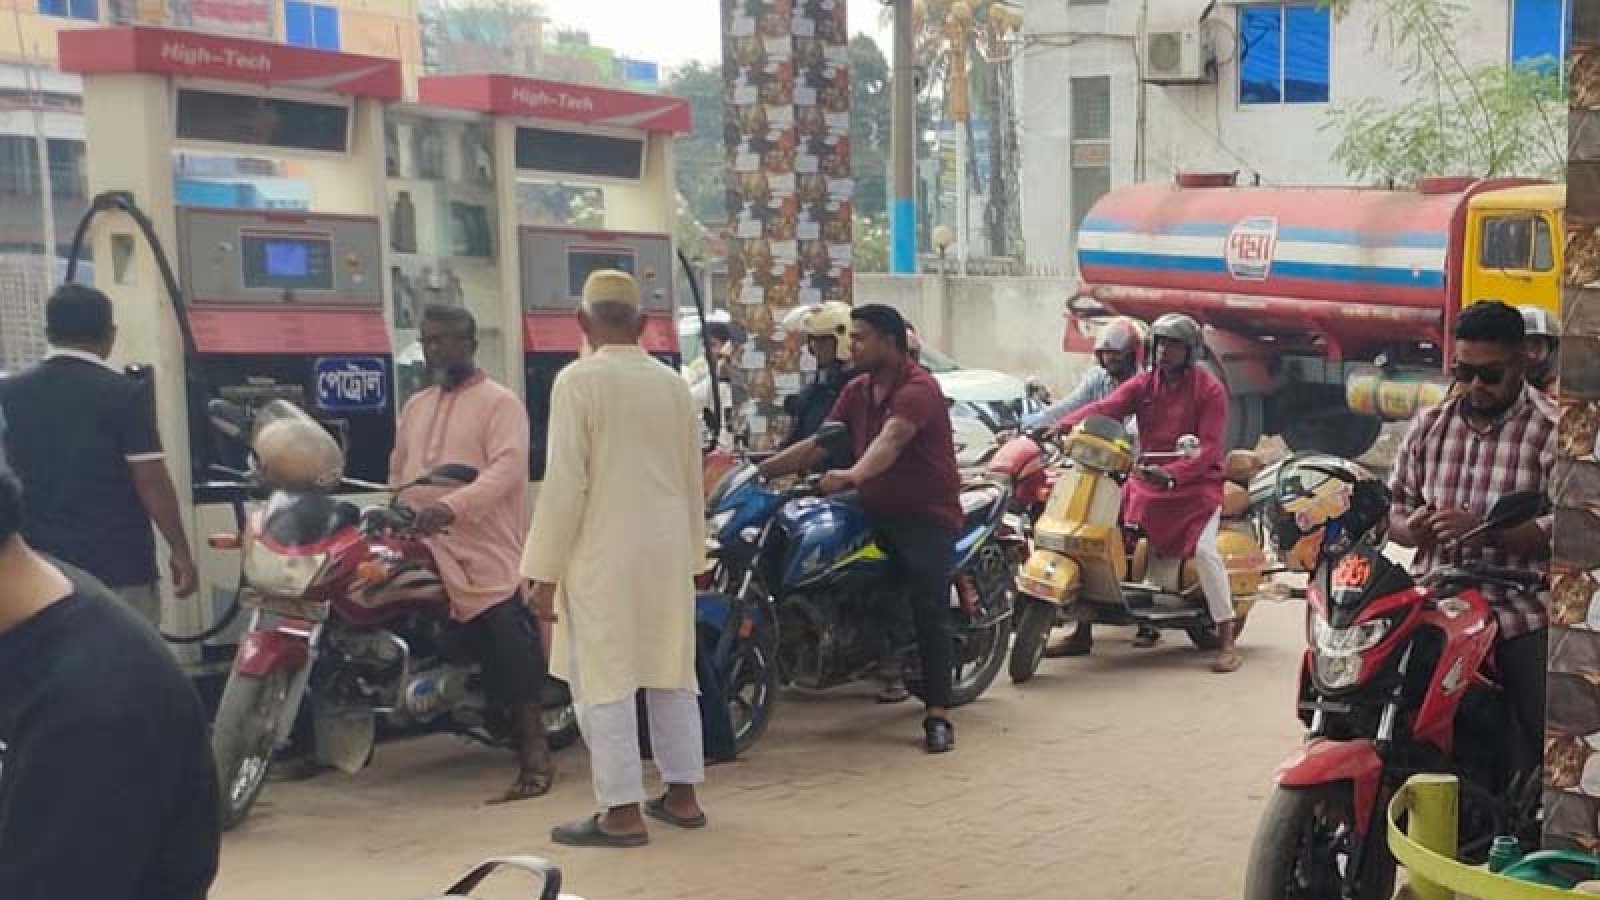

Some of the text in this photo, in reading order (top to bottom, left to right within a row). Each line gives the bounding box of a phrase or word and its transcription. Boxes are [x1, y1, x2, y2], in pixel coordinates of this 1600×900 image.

[161, 41, 271, 71] High-Tech
[511, 87, 593, 112] High-Tech
[317, 363, 384, 401] পেট্রোল
